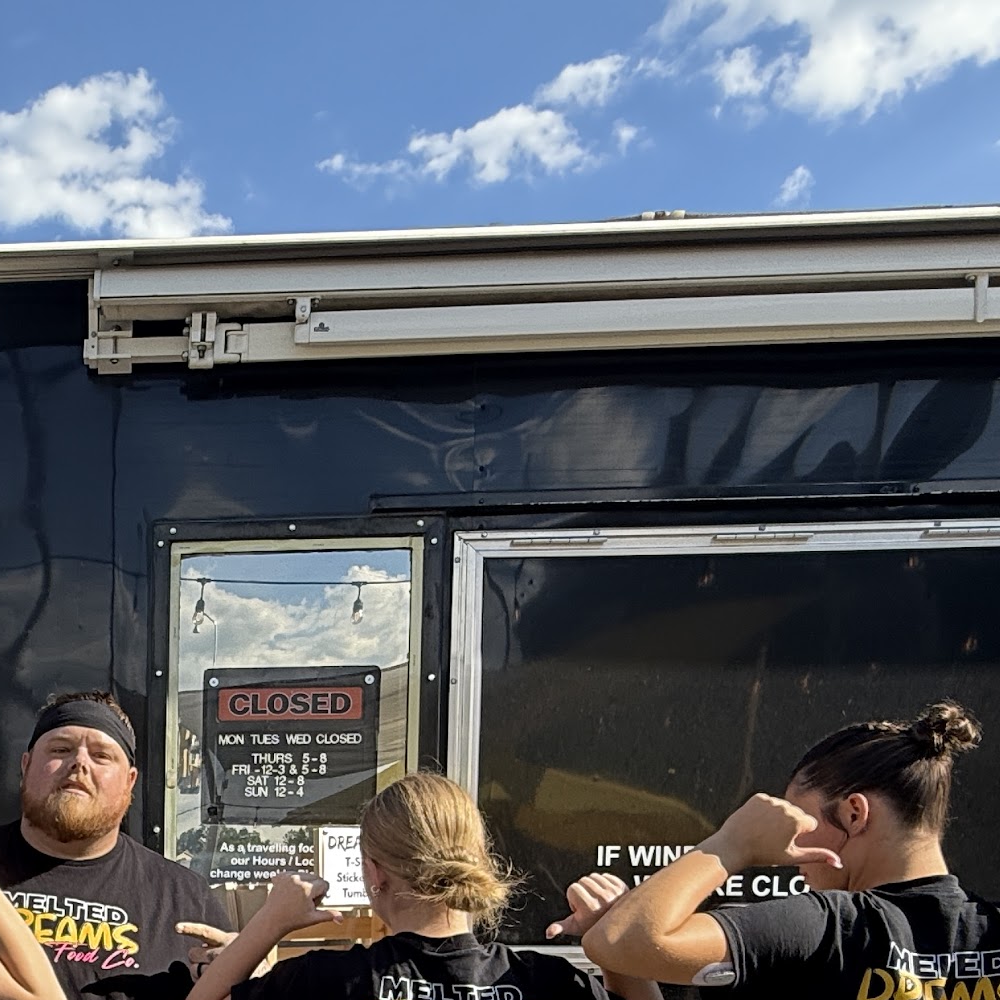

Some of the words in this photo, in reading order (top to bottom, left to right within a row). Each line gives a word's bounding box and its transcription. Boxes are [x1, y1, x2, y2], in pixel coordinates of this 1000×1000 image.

[228, 691, 352, 716] CLOSED
[218, 734, 245, 745] MON
[250, 734, 280, 745] TUES
[285, 733, 312, 745] WED
[316, 733, 362, 744] CLOSED
[251, 753, 293, 764] THURS
[231, 764, 250, 775] FRI
[289, 764, 298, 775] &
[246, 775, 269, 786] SAT
[244, 786, 268, 797] SUN
[220, 842, 235, 852] As
[237, 844, 246, 853] a
[247, 842, 295, 855] traveling
[231, 857, 250, 866] our
[252, 856, 286, 866] Hours
[597, 845, 621, 867] IF
[210, 870, 251, 882] change
[45, 941, 99, 964] Food
[101, 949, 140, 970] Co.
